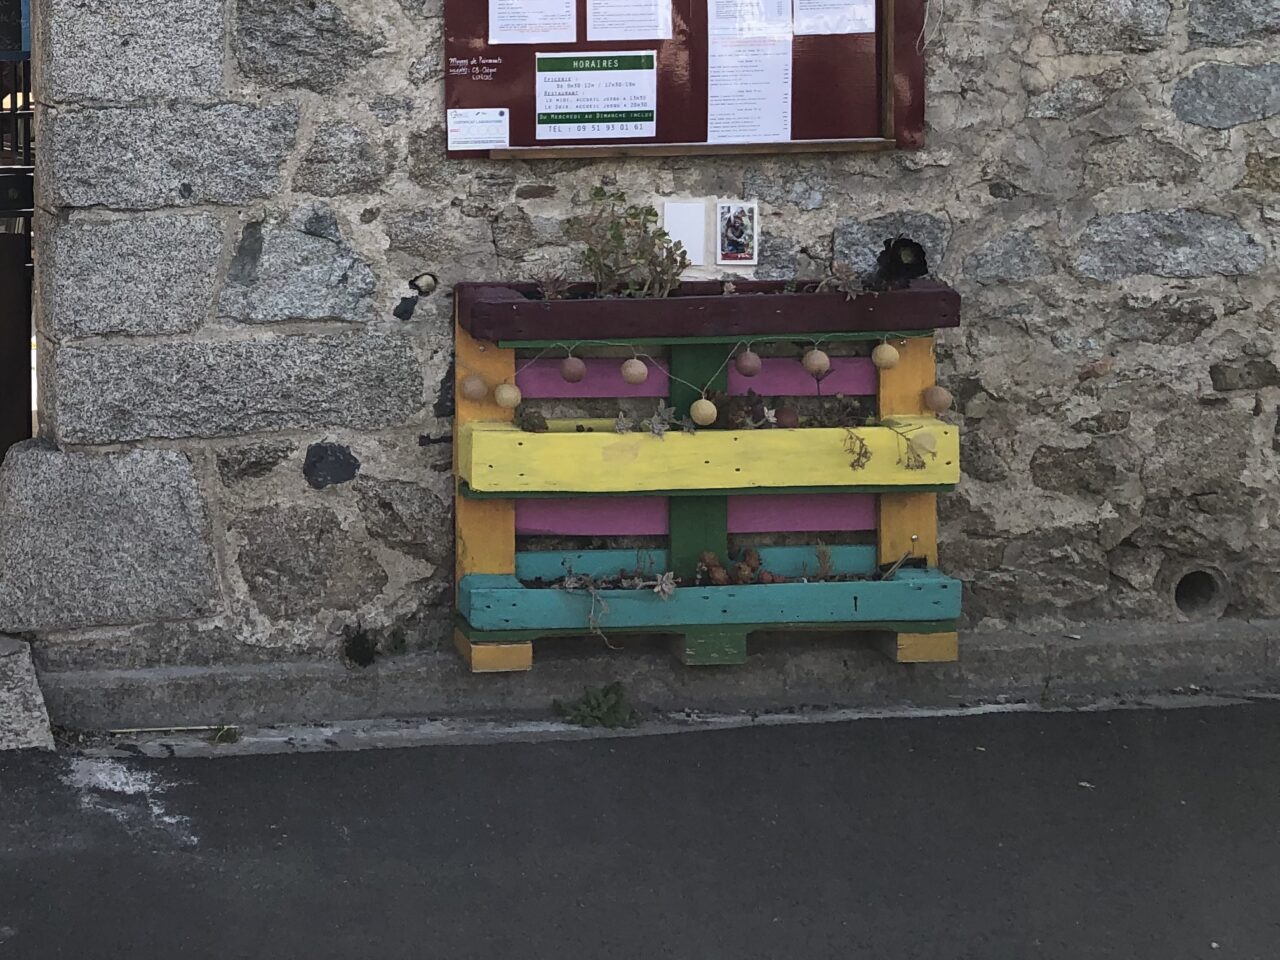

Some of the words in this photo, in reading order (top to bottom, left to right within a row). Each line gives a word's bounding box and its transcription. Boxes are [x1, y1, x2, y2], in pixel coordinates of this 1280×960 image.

[573, 60, 619, 68] HORAIRES
[548, 125, 563, 133] TEL
[576, 124, 586, 132] 09
[591, 124, 601, 132] 51
[606, 124, 615, 132] 93
